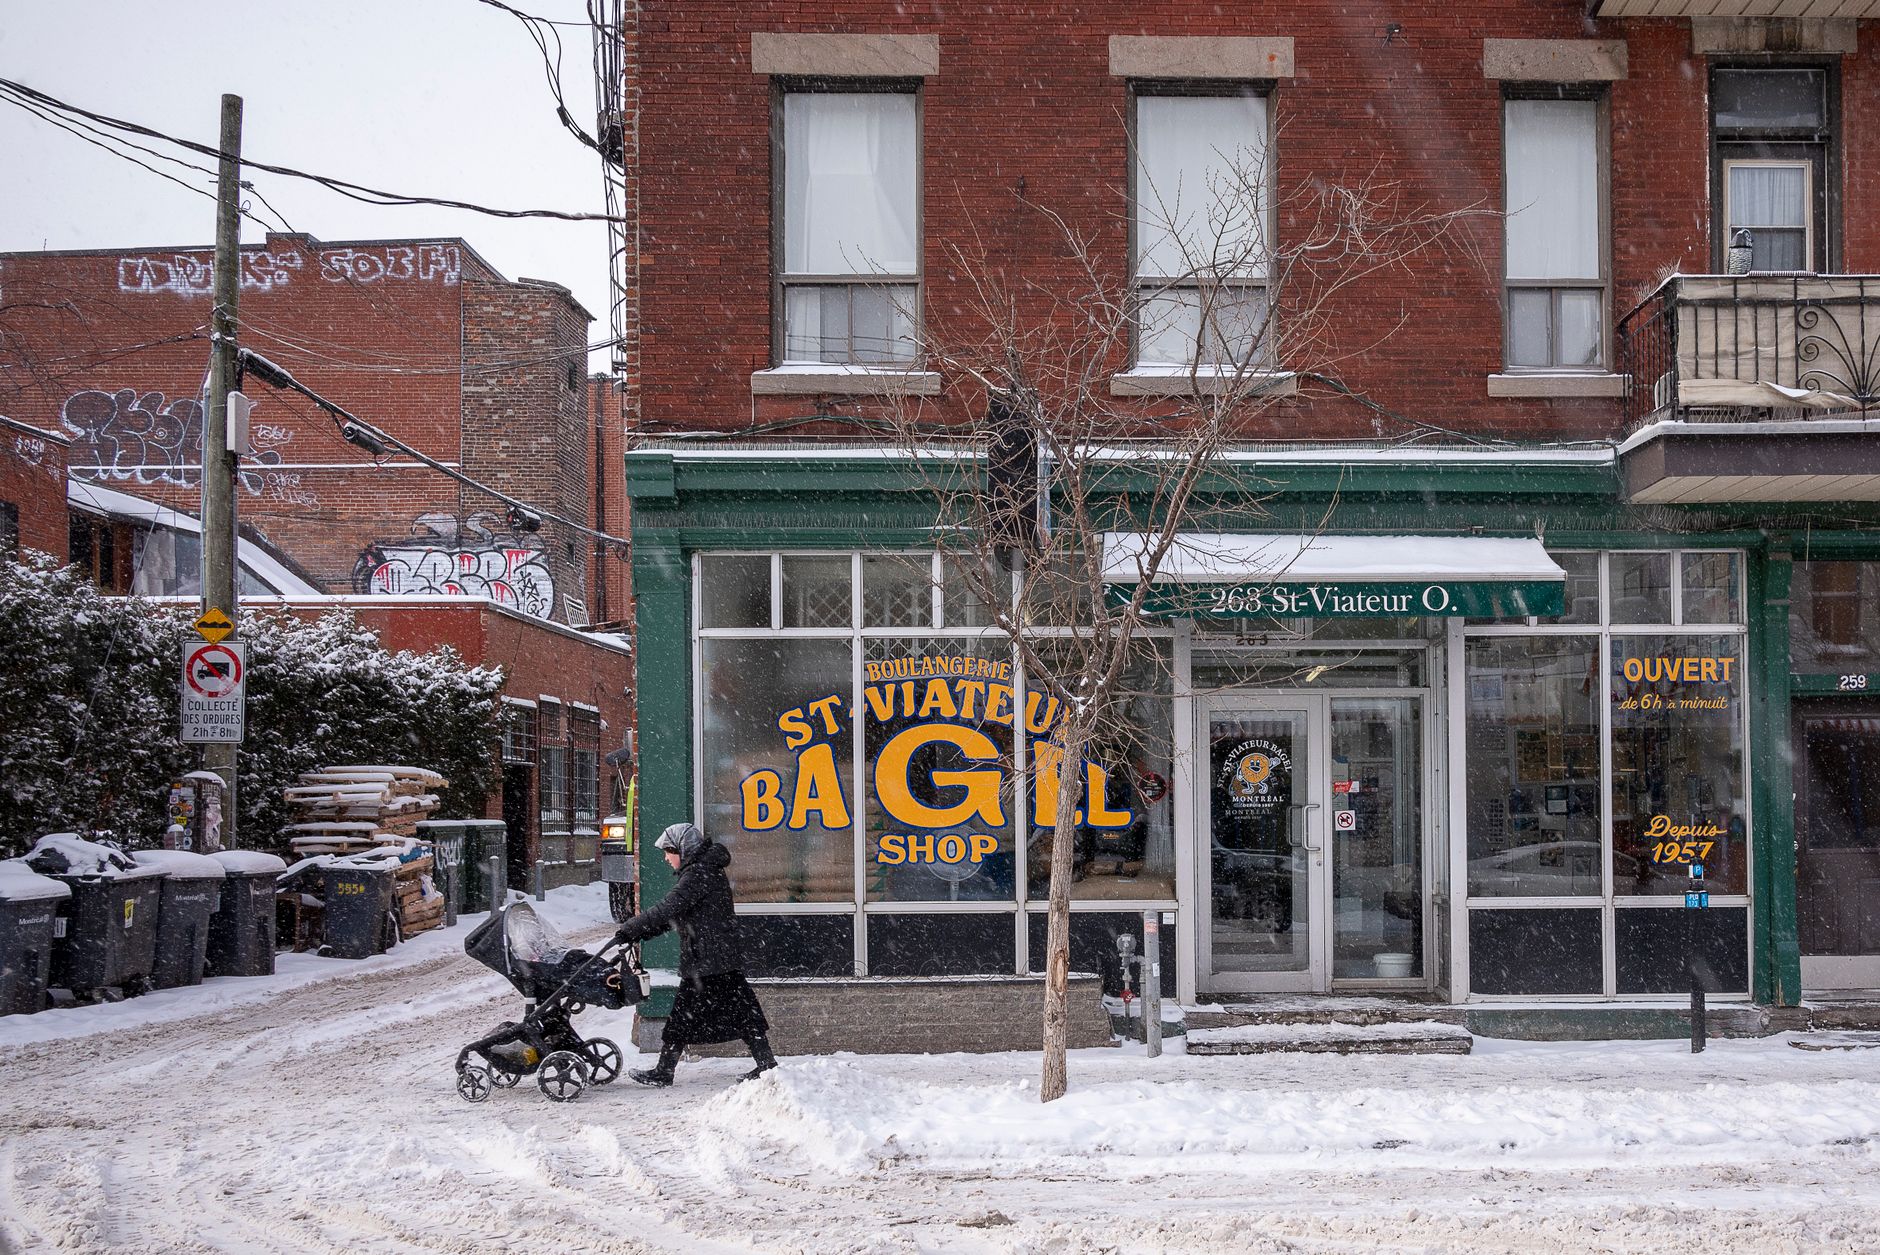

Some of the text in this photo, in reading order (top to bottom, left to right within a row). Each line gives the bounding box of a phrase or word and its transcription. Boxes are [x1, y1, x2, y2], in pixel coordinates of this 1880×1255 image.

[1210, 585, 1458, 614] 263 St-Viateur O.
[866, 655, 1011, 682] BOULANGERIE
[1622, 657, 1735, 683] OUVERT
[1840, 674, 1866, 689] 259
[187, 700, 238, 711] COLLECTE
[1618, 696, 1638, 710] de
[1679, 696, 1728, 710] minuit
[183, 713, 241, 725] DES ORDURES
[192, 726, 209, 738] 21h
[1643, 815, 1728, 841] Depuis
[876, 833, 1000, 866] SHOP
[1651, 841, 1714, 864] 1957
